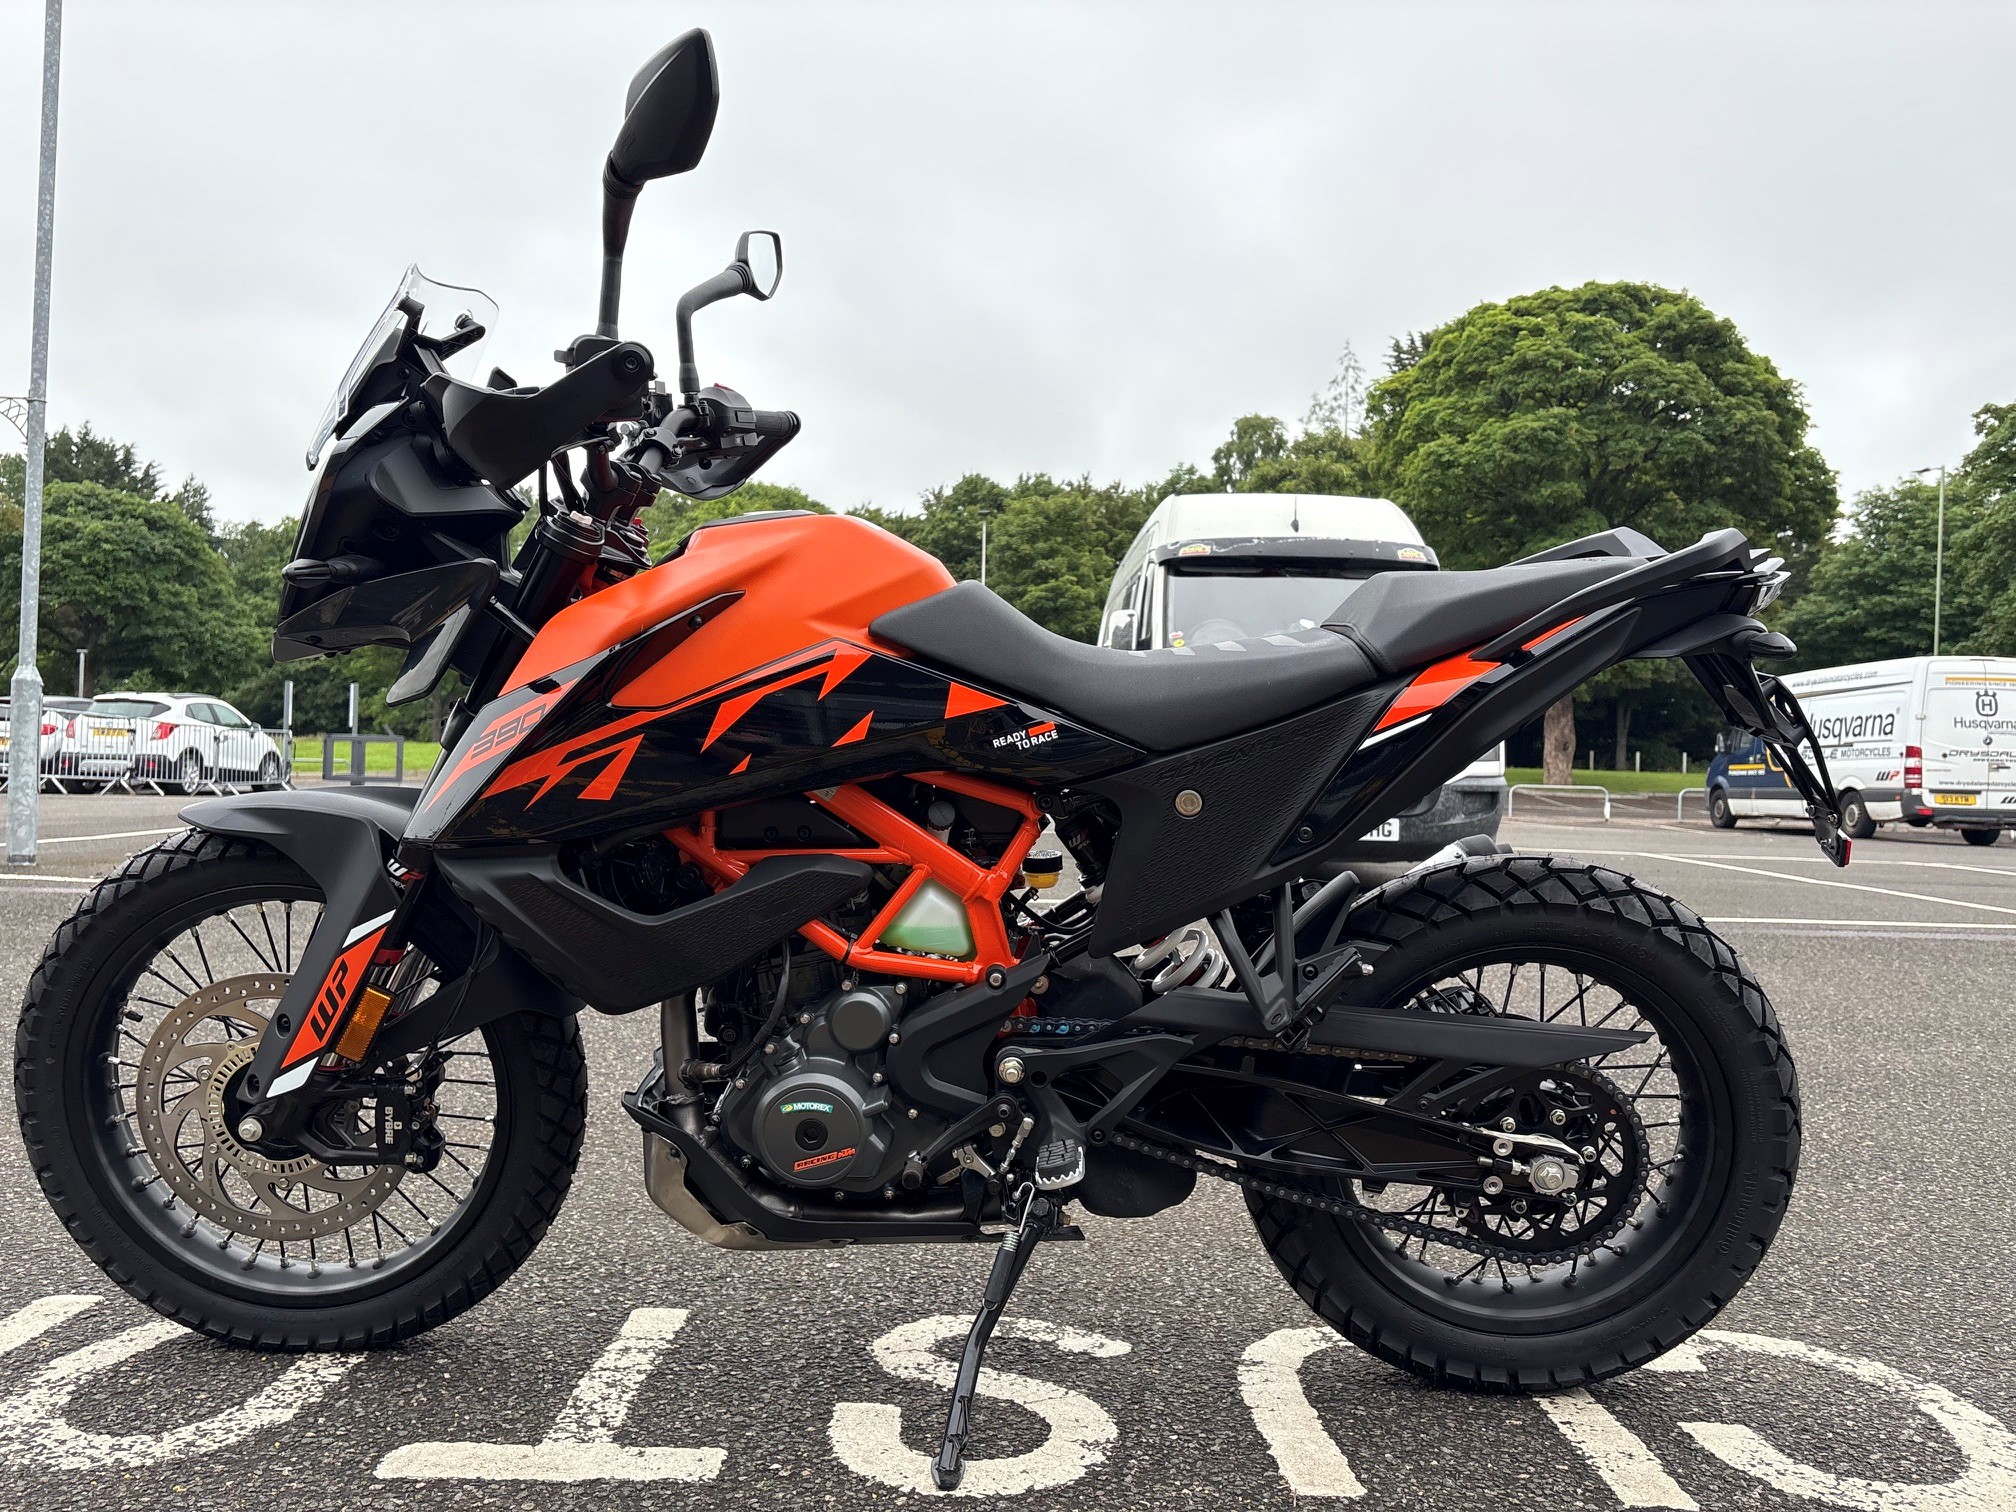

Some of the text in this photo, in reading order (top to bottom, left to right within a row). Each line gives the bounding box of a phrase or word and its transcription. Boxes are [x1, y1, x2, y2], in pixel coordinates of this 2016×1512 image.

[471, 703, 547, 760] 390
[993, 730, 1026, 748] READY
[1810, 713, 1895, 746] usqvarna
[1015, 730, 1059, 750] TO RACE
[1840, 747, 1892, 758] MOTORCYCLES
[310, 958, 349, 1043] WP
[793, 1102, 831, 1112] MOTOREX
[384, 1106, 394, 1145] BYBRE
[795, 1152, 837, 1170] RACING
